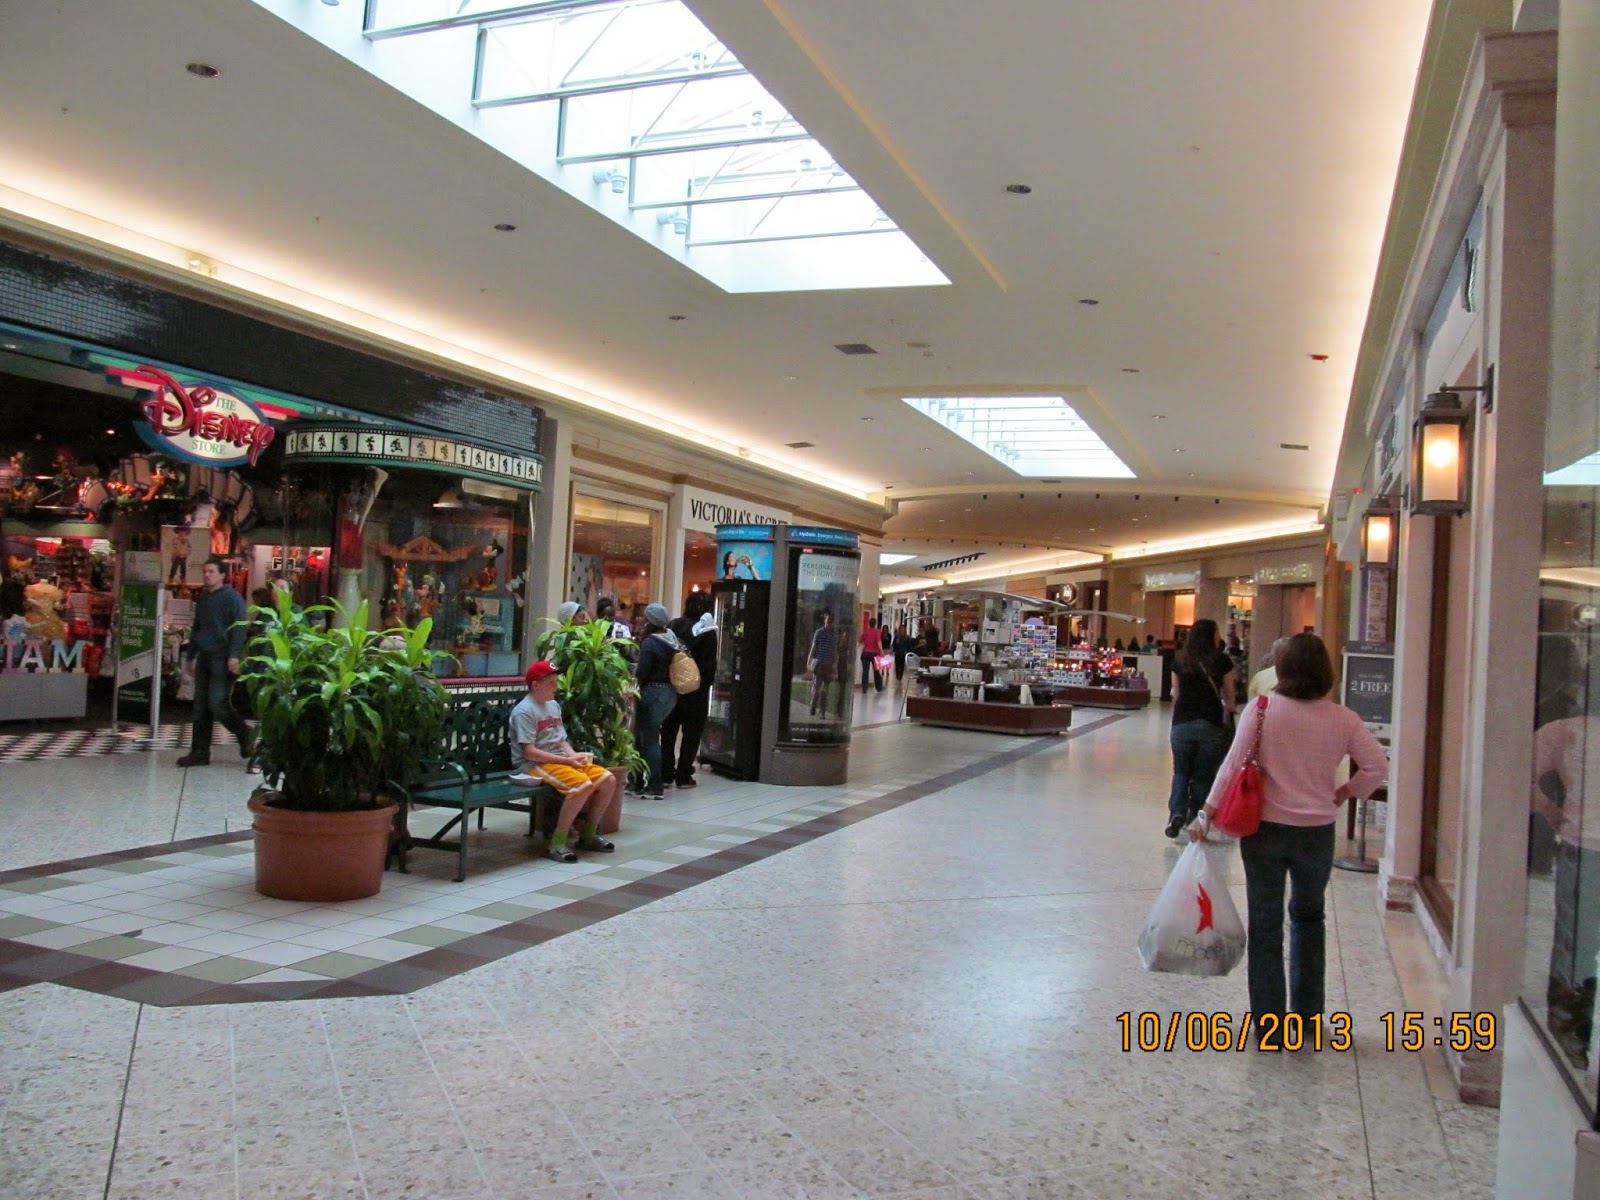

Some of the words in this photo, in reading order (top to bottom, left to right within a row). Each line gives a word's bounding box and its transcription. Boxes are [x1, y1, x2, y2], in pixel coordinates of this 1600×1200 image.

[215, 397, 236, 411] THE
[192, 440, 226, 455] STORE
[691, 499, 751, 525] VICTORIA'S
[754, 514, 789, 526] SEC
[1350, 680, 1359, 691] 2
[1360, 681, 1392, 693] FREE
